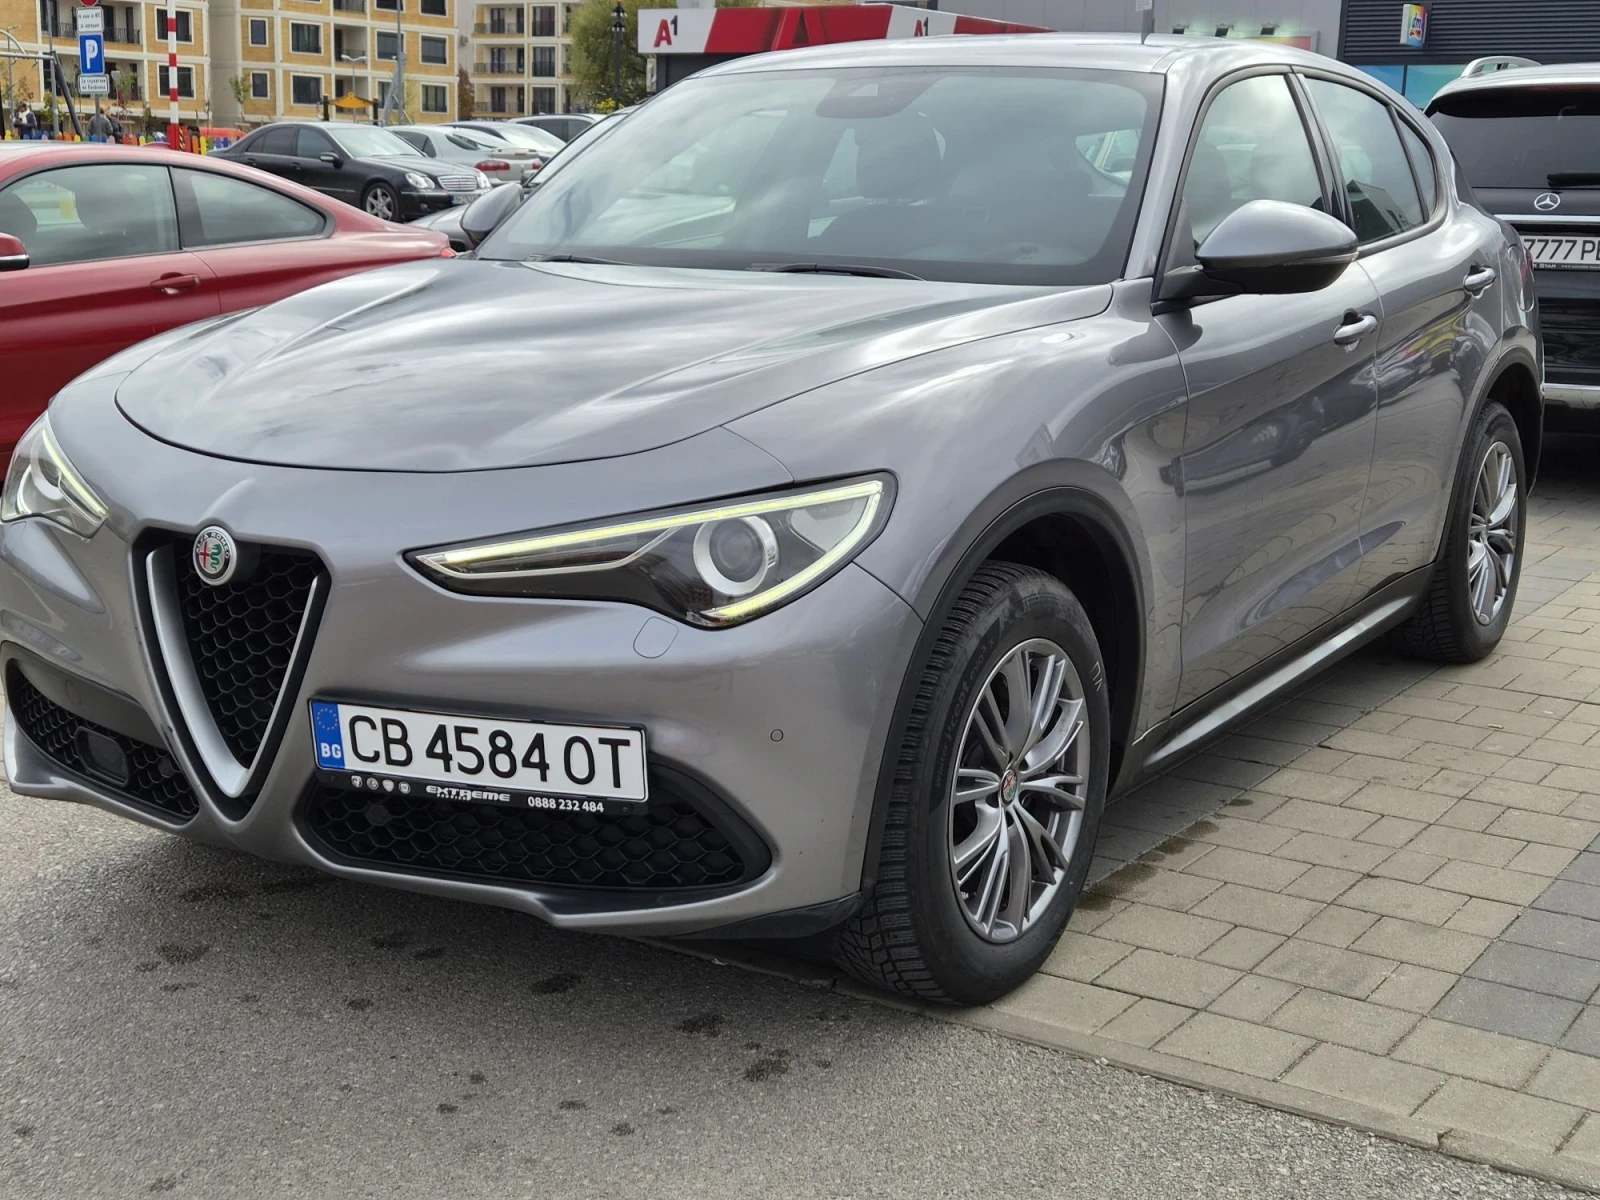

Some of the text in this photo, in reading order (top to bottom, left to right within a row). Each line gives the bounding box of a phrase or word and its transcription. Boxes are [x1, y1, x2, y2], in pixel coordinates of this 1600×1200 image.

[654, 15, 678, 48] A1
[914, 17, 928, 37] A1
[85, 39, 98, 69] P
[1523, 239, 1578, 260] 7777
[321, 742, 342, 759] BG
[349, 715, 630, 788] CB 4584 OT
[425, 785, 511, 801] EXTREME
[527, 796, 604, 813] 0888 232 484
